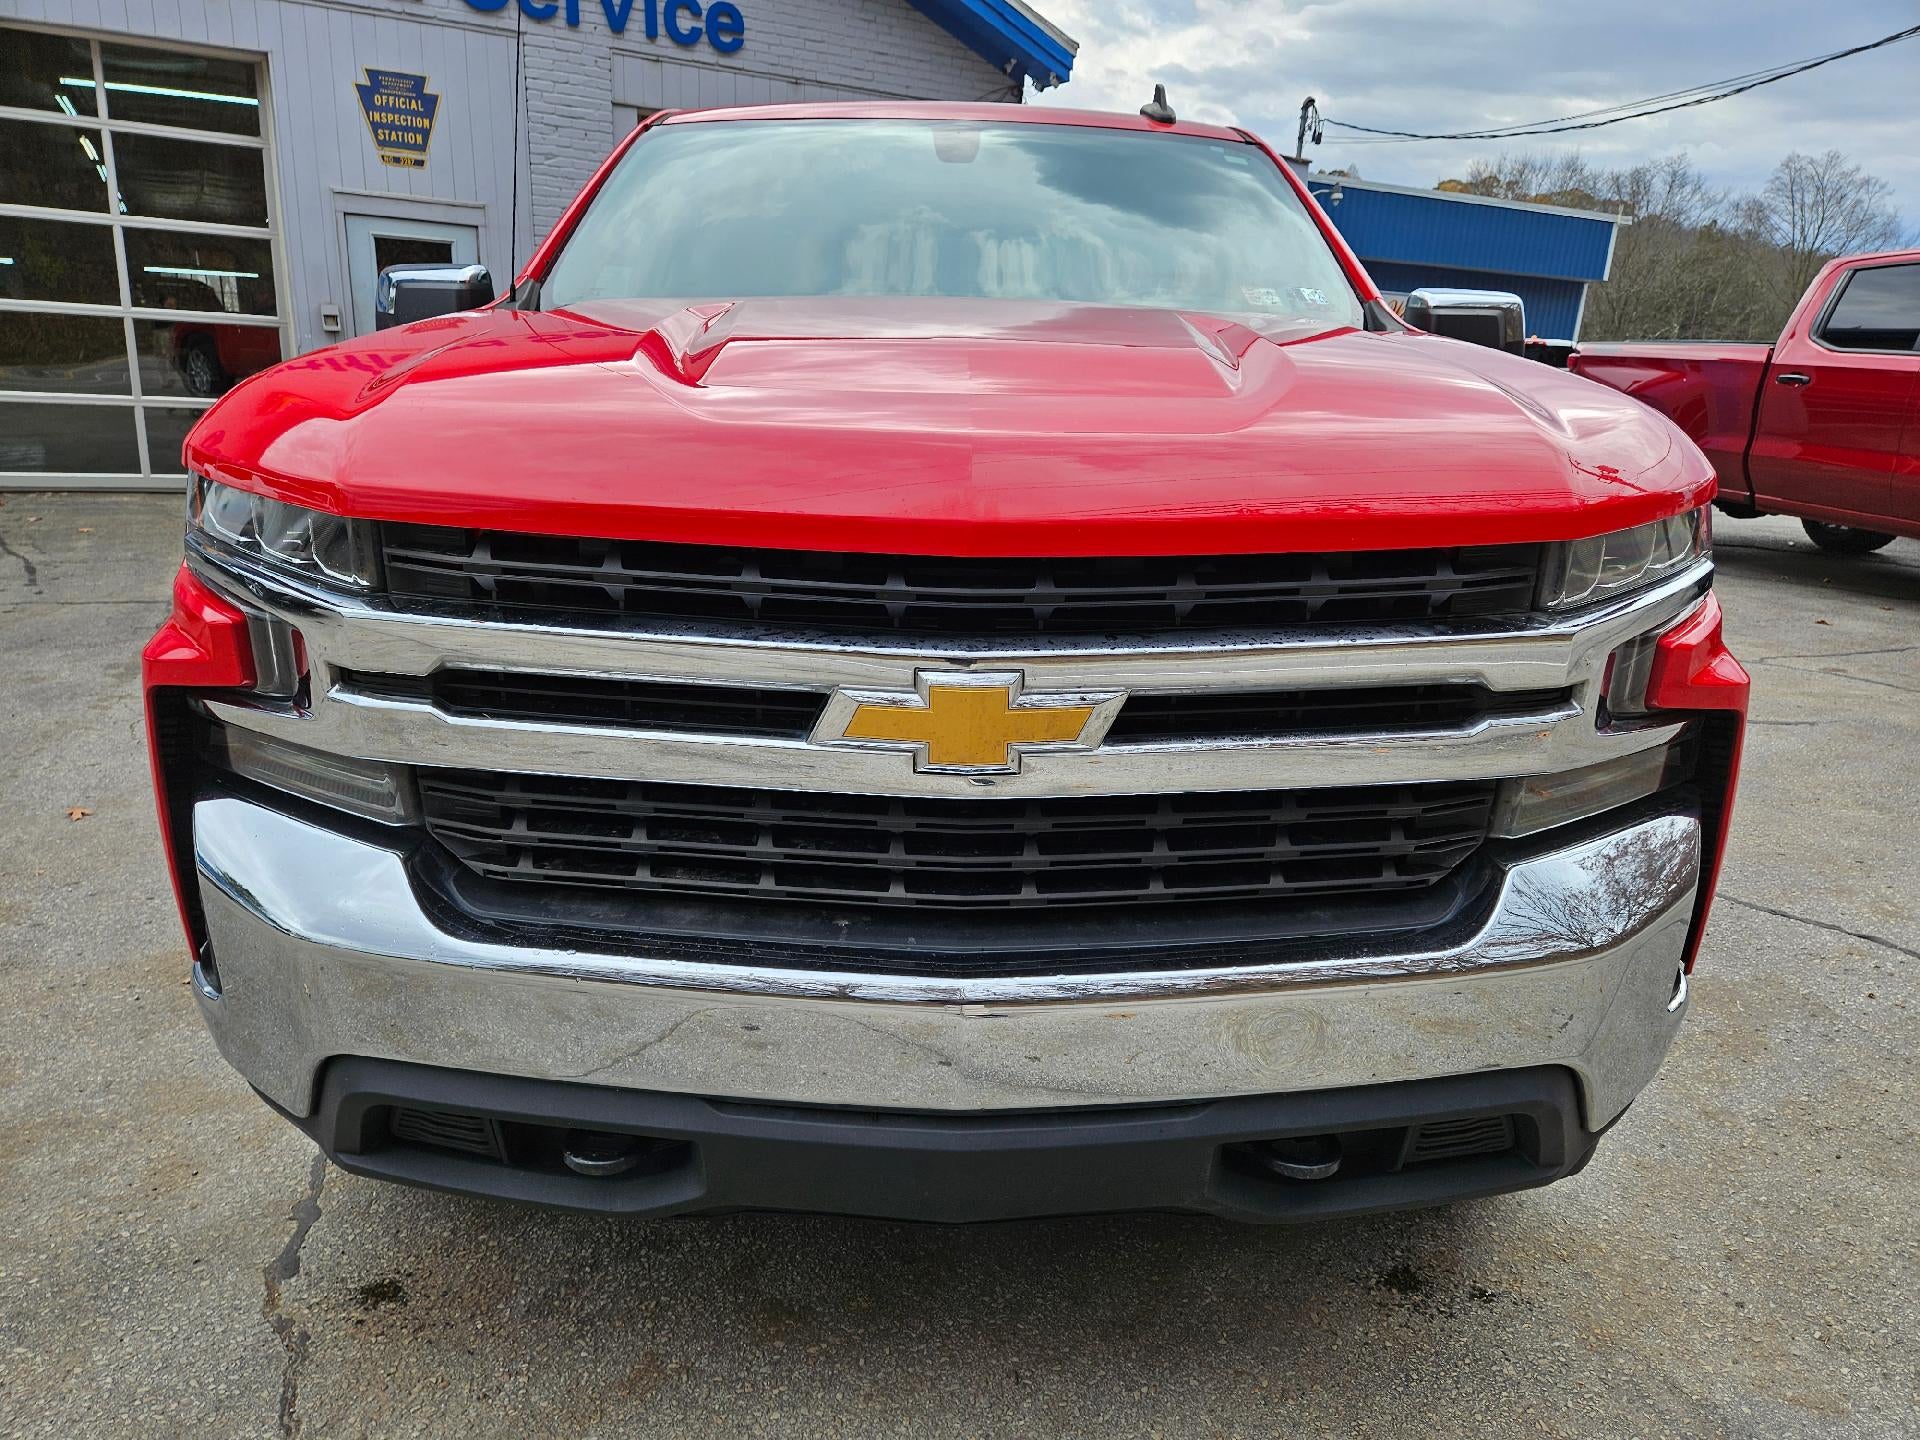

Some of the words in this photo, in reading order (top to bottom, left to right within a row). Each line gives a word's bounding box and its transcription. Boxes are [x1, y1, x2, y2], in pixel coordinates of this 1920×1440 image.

[463, 0, 745, 53] rvice
[374, 94, 424, 111] OFFICIAL
[369, 111, 430, 129] INSPECTION
[377, 128, 423, 145] STATION
